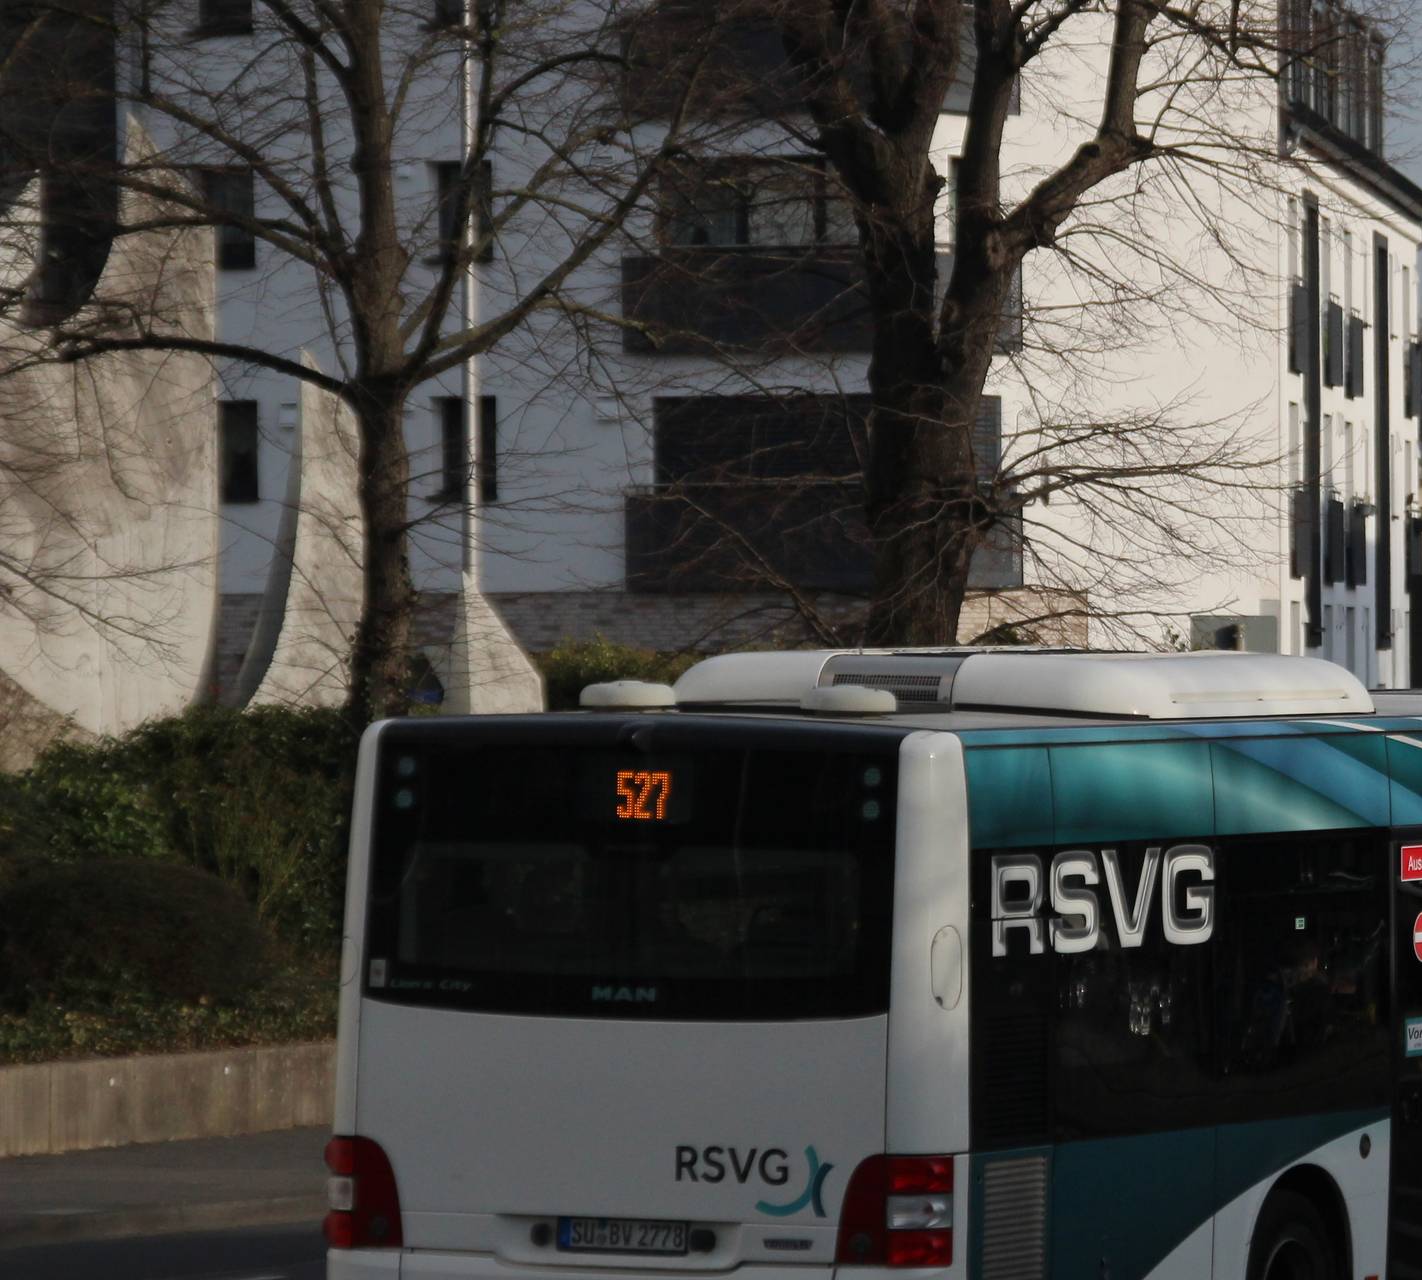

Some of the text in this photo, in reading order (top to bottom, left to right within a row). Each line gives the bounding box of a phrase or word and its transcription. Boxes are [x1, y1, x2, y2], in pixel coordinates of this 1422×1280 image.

[616, 771, 670, 819] 527
[991, 844, 1215, 957] RSVG
[592, 986, 657, 1002] MAN
[674, 1145, 789, 1186] RSVG
[571, 1221, 683, 1249] SU BV 2778
